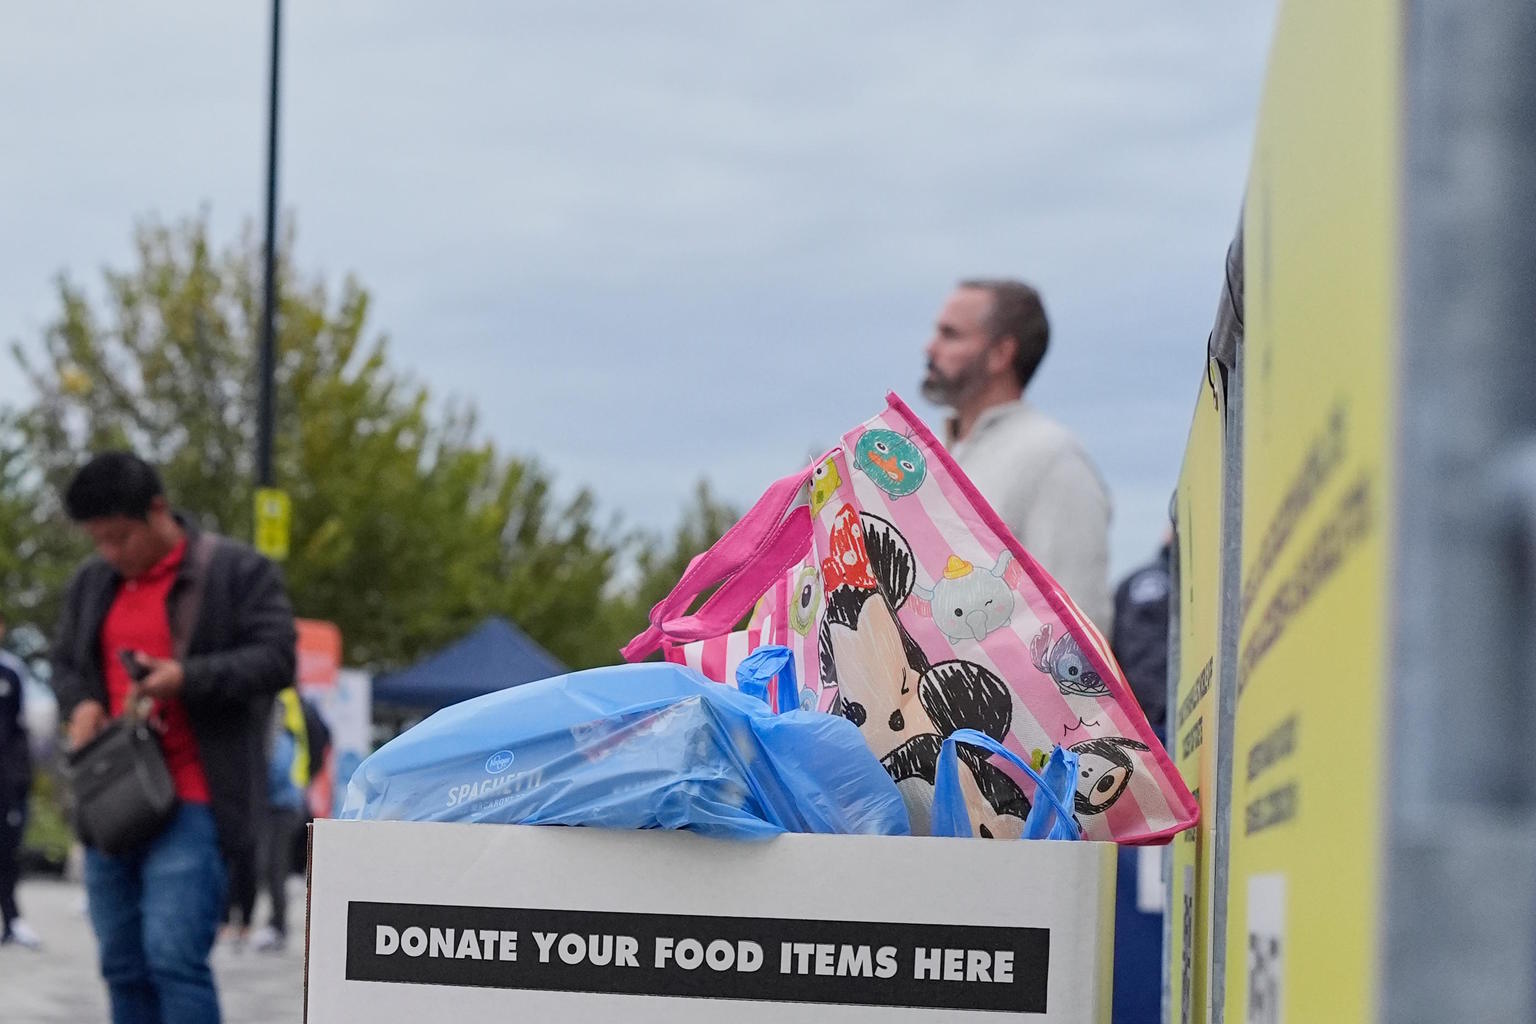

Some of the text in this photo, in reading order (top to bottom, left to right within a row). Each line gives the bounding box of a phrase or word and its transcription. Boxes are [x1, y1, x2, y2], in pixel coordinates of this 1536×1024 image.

[375, 924, 1015, 983] DONATE YOUR FOOD ITEMS HERE
